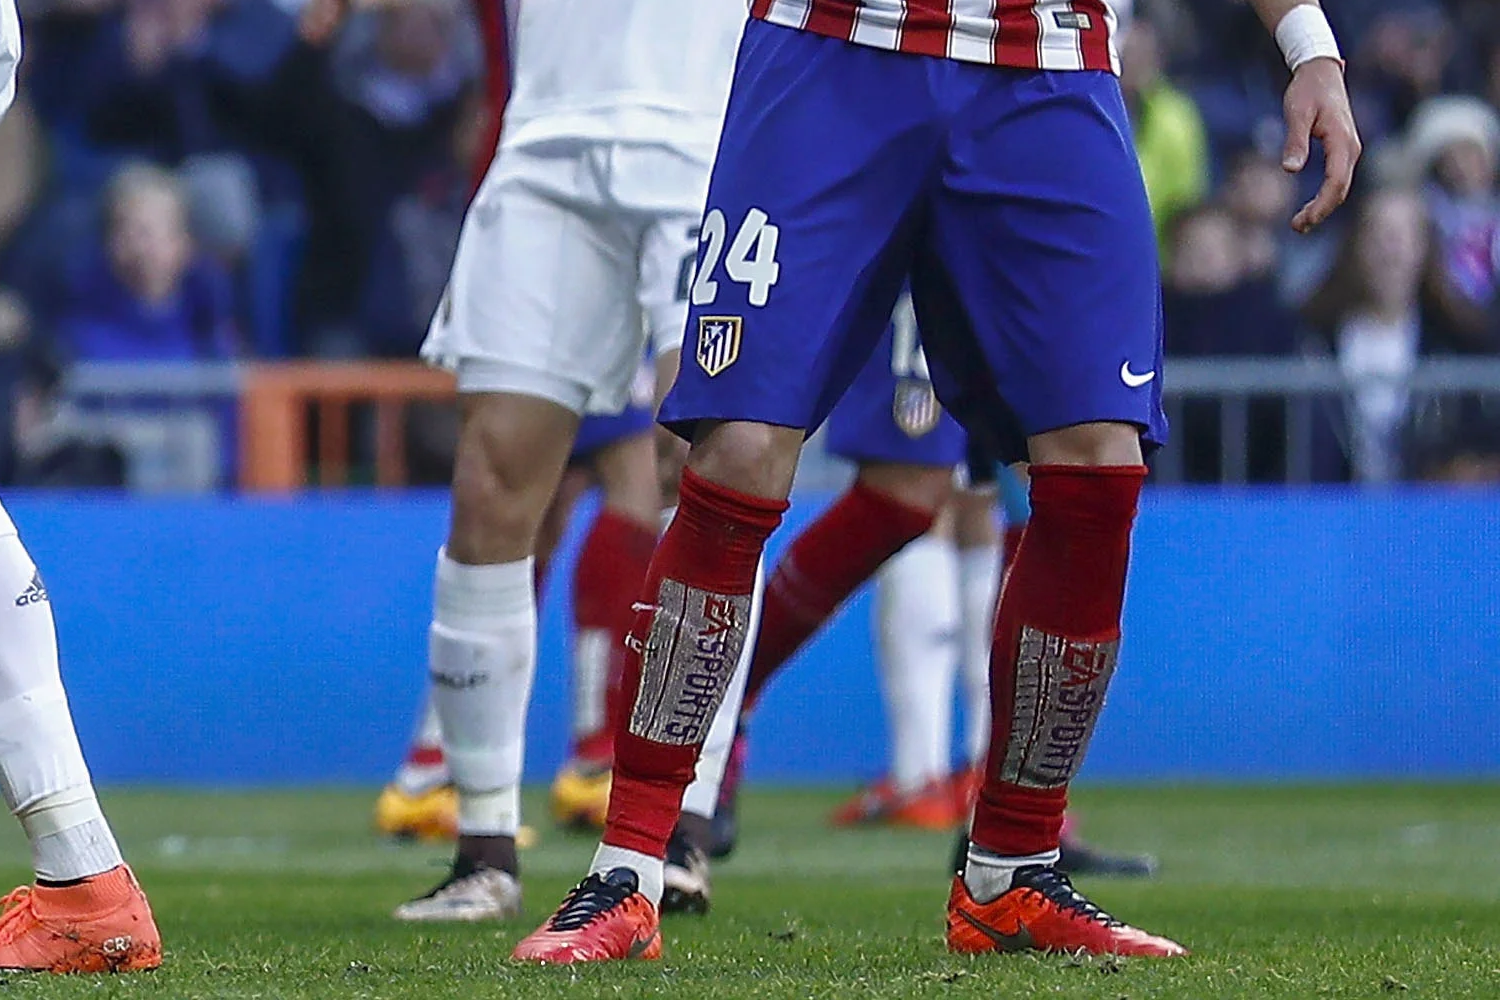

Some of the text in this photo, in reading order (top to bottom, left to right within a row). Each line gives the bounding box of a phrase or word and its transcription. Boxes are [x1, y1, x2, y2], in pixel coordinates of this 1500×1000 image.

[692, 207, 780, 307] 24
[664, 638, 728, 742] SPORTS
[1039, 687, 1098, 779] SPORT
